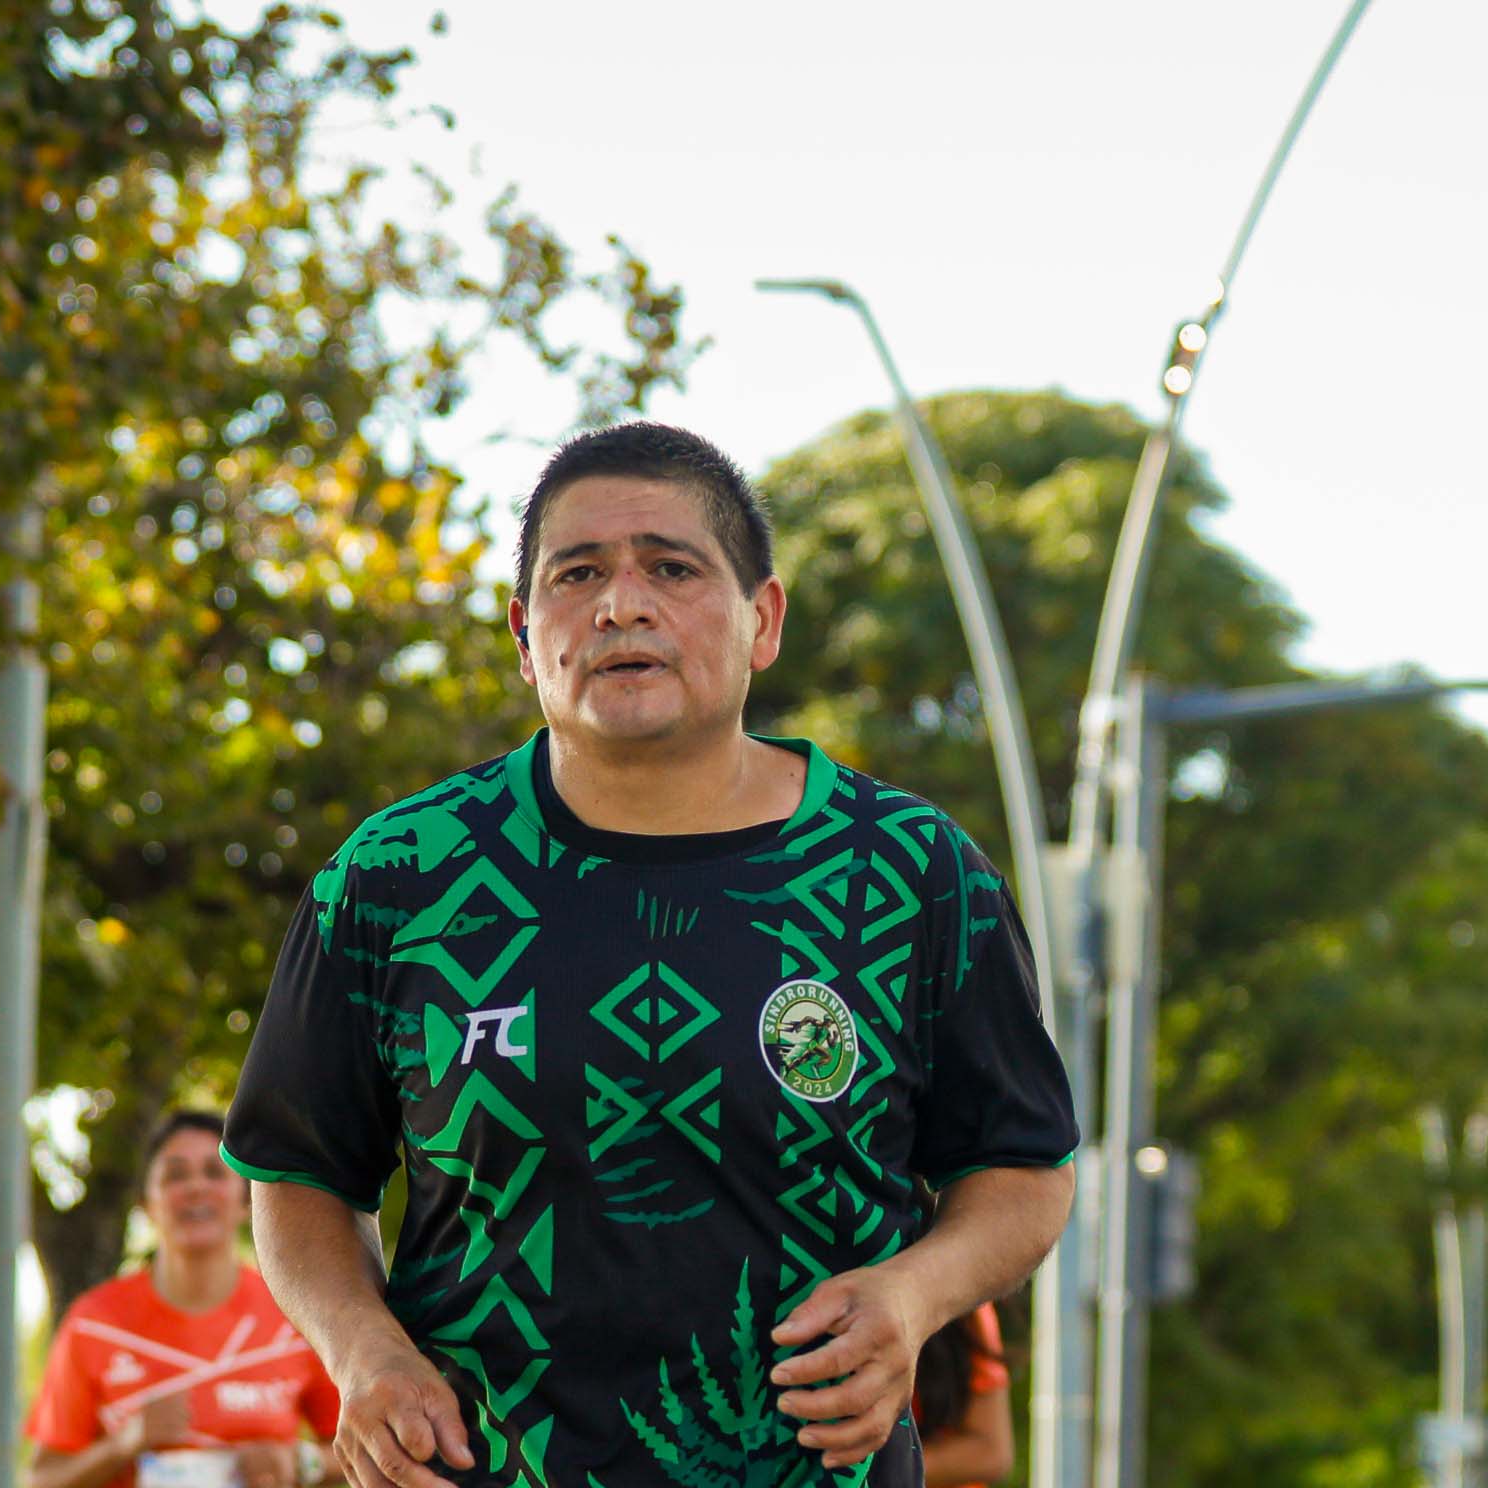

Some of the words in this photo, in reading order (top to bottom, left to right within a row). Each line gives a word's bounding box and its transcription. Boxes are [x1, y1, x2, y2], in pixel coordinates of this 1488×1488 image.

[461, 1006, 528, 1064] FC
[765, 985, 854, 1052] SINDRORUNNING
[792, 1077, 832, 1095] 2024
